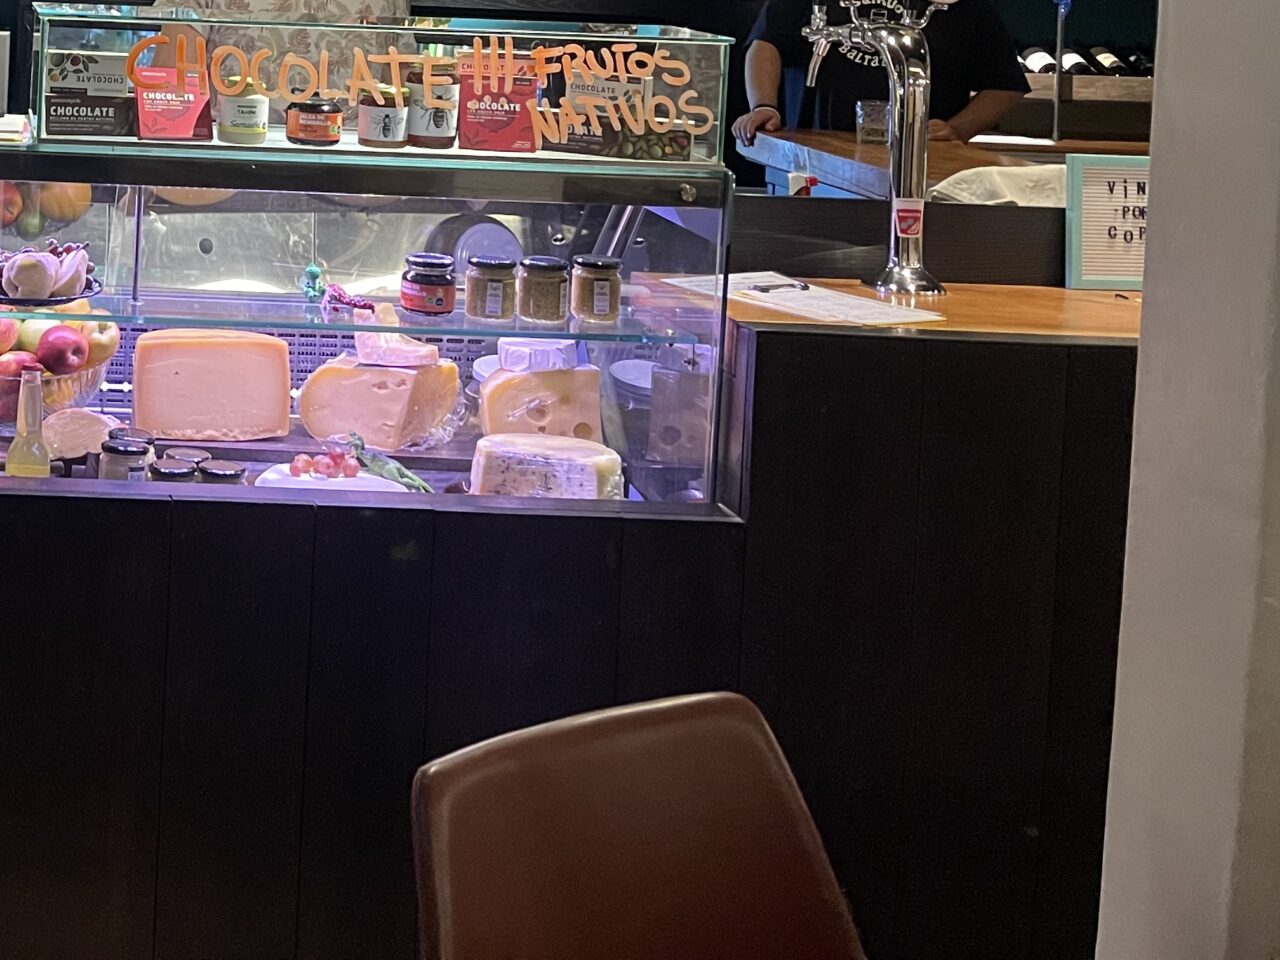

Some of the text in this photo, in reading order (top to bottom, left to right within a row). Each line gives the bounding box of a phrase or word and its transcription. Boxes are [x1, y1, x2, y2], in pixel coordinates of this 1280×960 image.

[531, 43, 692, 88] FRUTOS
[143, 92, 195, 101] CHOCOLTE
[50, 106, 115, 117] CHOCOLATE
[526, 90, 715, 150] NATIVOS
